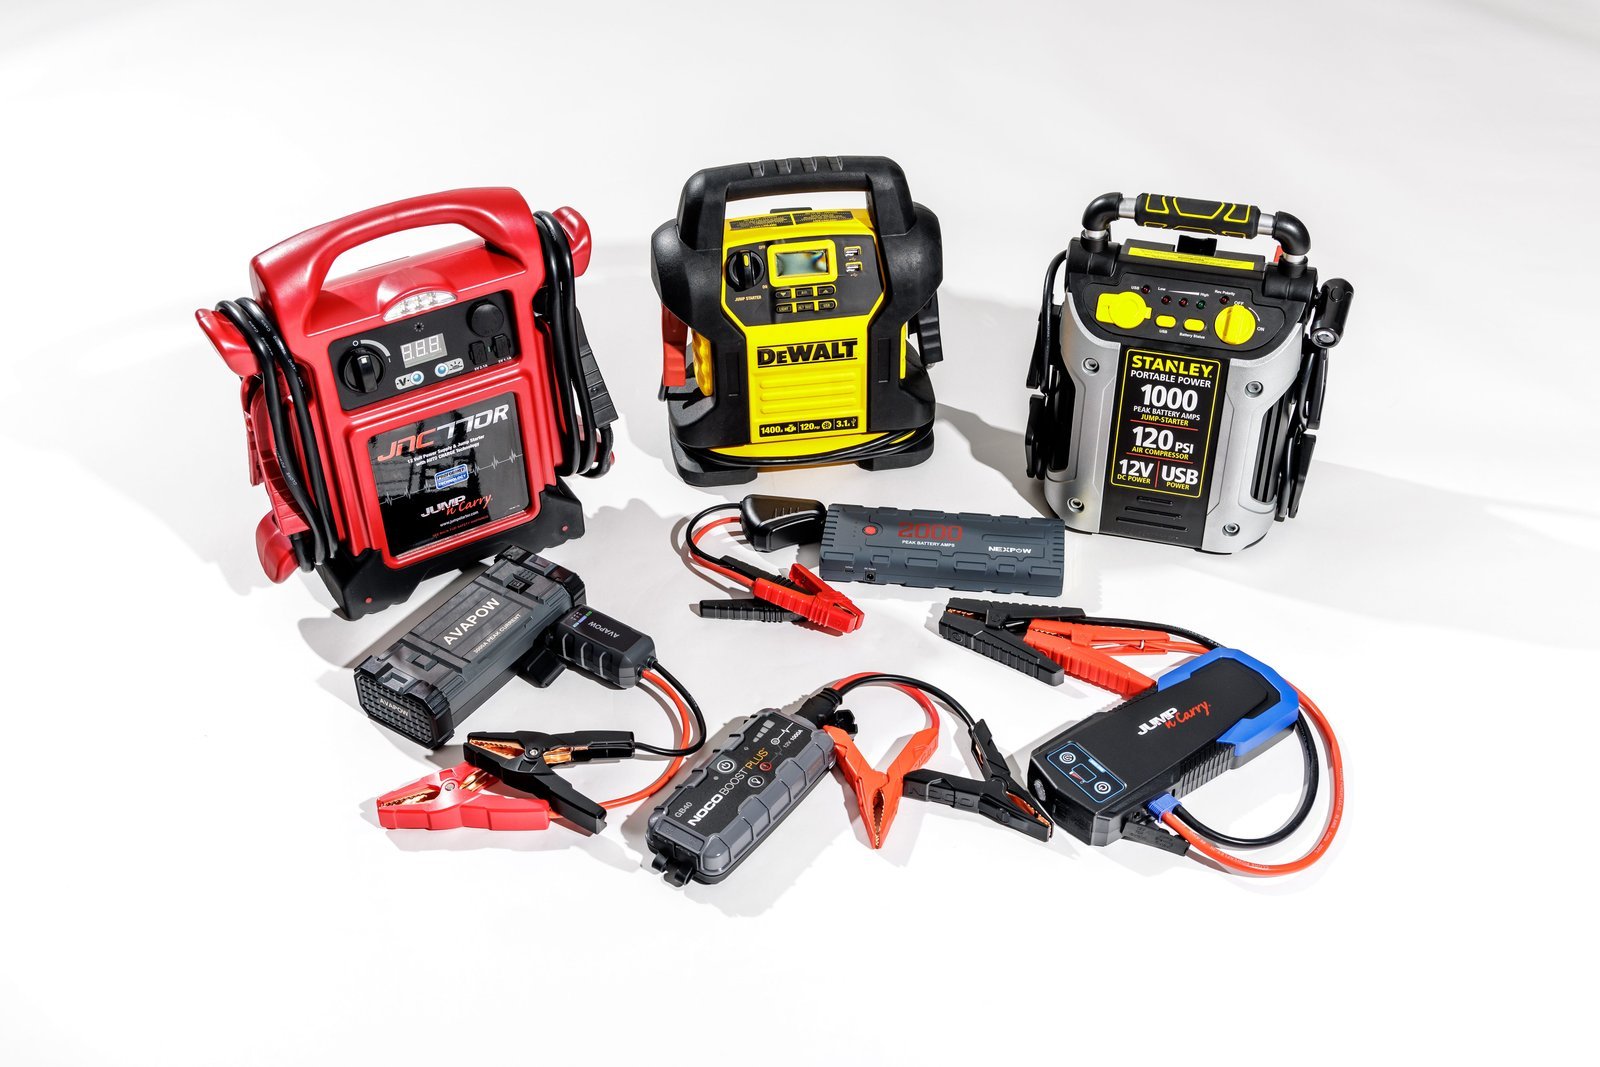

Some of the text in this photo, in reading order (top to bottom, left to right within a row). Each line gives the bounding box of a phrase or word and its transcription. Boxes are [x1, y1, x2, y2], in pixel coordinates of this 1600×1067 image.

[1132, 354, 1214, 379] STANLEY
[1130, 370, 1212, 388] PORTABLE POWER
[1141, 384, 1198, 412] 1000
[1133, 405, 1200, 421] PEAK BATTERY AMPS
[1141, 414, 1189, 426] JUMP-STARTER
[423, 452, 437, 461] Power
[438, 446, 453, 456] Supply
[457, 439, 470, 448] Jump
[1132, 426, 1194, 454] 120 PSI
[438, 451, 456, 460] CHARGE
[456, 442, 480, 454] Technology
[1144, 448, 1189, 460] COMPRESSOR
[1119, 458, 1154, 478] 12V
[1161, 464, 1199, 485] USB
[1127, 475, 1151, 484] POWER
[1166, 482, 1190, 490] POWER
[420, 495, 466, 518] JUMP
[459, 494, 492, 510] Carry
[897, 521, 963, 542] 2000
[443, 598, 500, 646] AVAPOW
[486, 629, 500, 642] PEAK
[499, 613, 522, 632] CURRENT
[587, 620, 620, 639] AVAPOW
[1137, 707, 1178, 735] JUMP
[1175, 700, 1210, 723] Carry
[687, 748, 769, 826] NOCO BOOST PLUS
[675, 802, 692, 818] GB40
